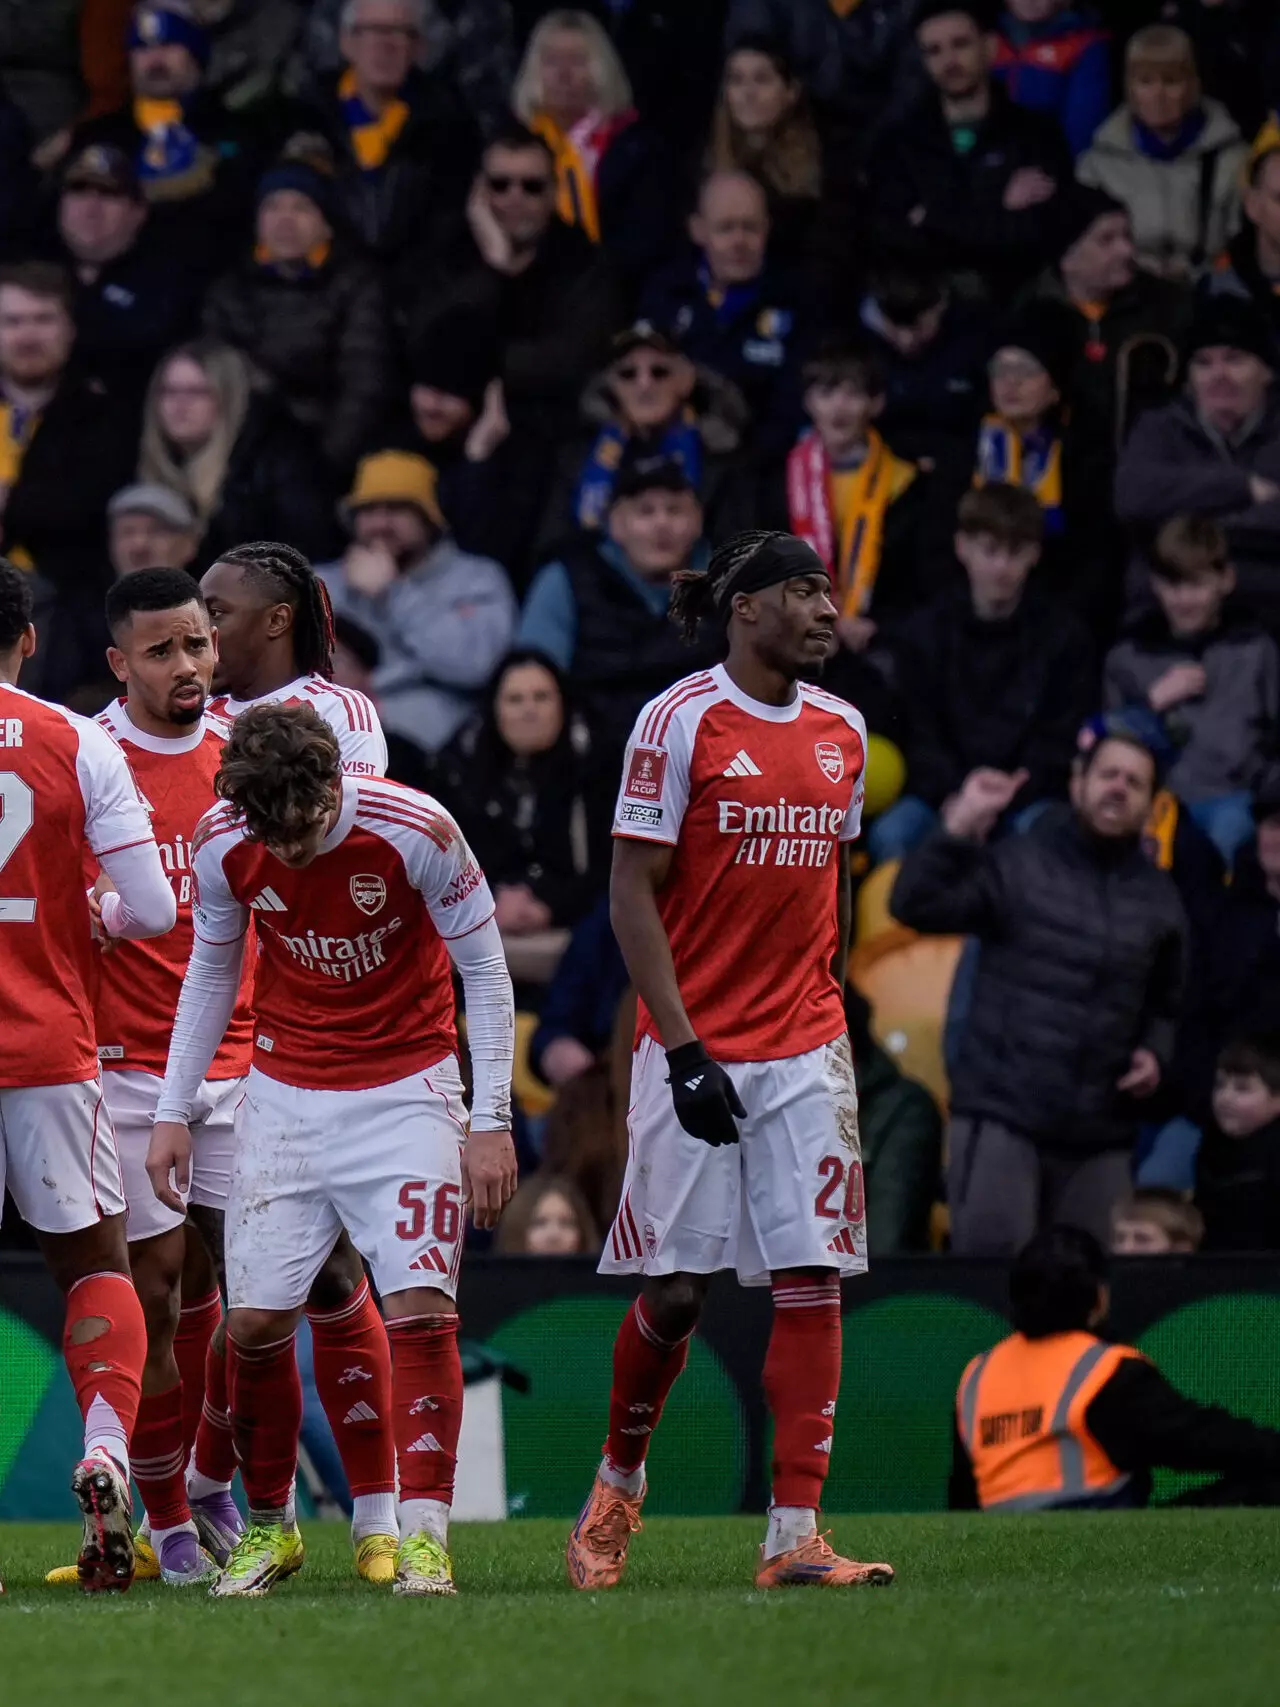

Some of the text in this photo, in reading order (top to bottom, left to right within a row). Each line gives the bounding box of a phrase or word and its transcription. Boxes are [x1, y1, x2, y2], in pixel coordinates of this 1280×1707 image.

[340, 760, 376, 775] VISIT
[630, 784, 657, 795] FA CUP
[631, 778, 657, 788] Emirates
[631, 813, 661, 826] racism
[633, 806, 659, 817] room
[717, 797, 847, 835] Emirate
[734, 838, 772, 865] FLY
[355, 880, 382, 890] Arsenal
[276, 916, 403, 960] mirates
[319, 942, 387, 983] BETTER
[814, 1154, 866, 1223] 20
[395, 1181, 462, 1244] 56
